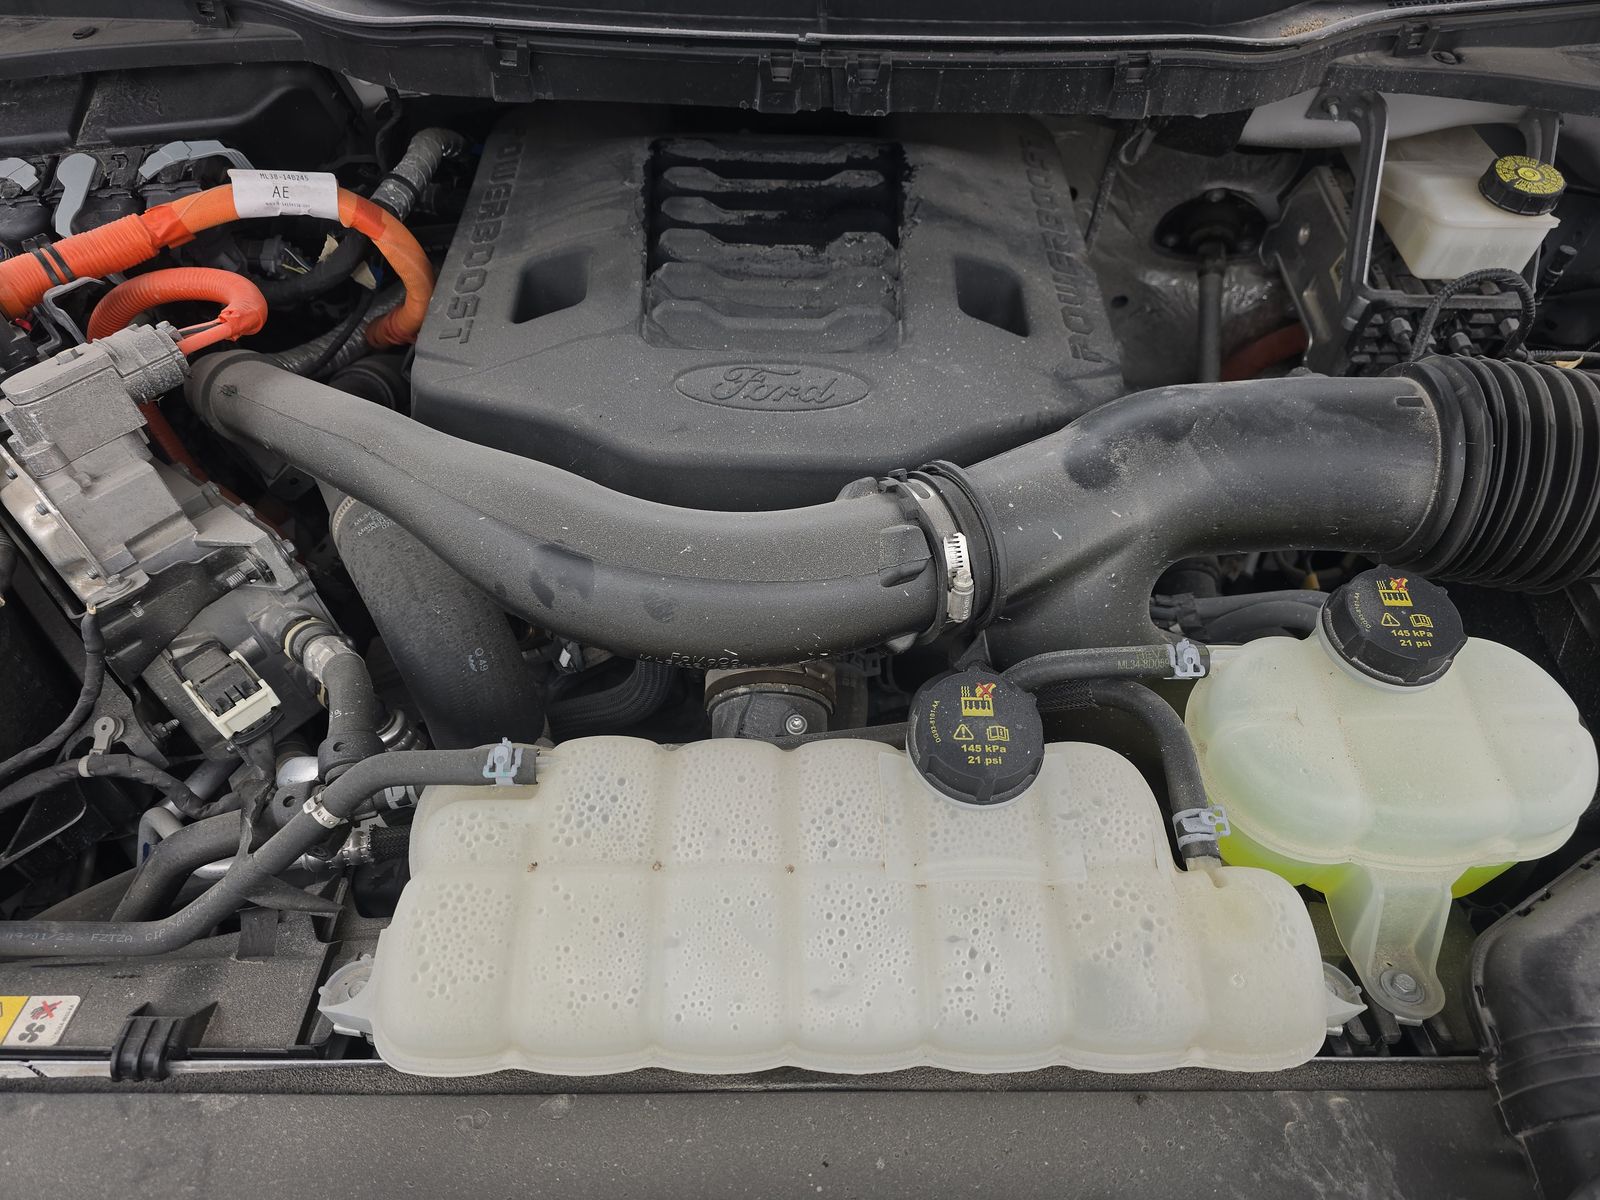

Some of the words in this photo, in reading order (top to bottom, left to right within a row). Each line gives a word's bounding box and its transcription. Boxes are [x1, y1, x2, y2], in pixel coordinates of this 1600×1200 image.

[272, 185, 289, 199] AE
[710, 367, 838, 403] Ford
[1391, 629, 1411, 638] 145
[1412, 630, 1434, 638] kPa
[1399, 639, 1413, 647] 21
[1415, 640, 1433, 648] psi
[961, 744, 982, 753] 145
[985, 744, 1007, 753] kPa
[967, 755, 981, 764] 21
[985, 755, 1002, 765] psi
